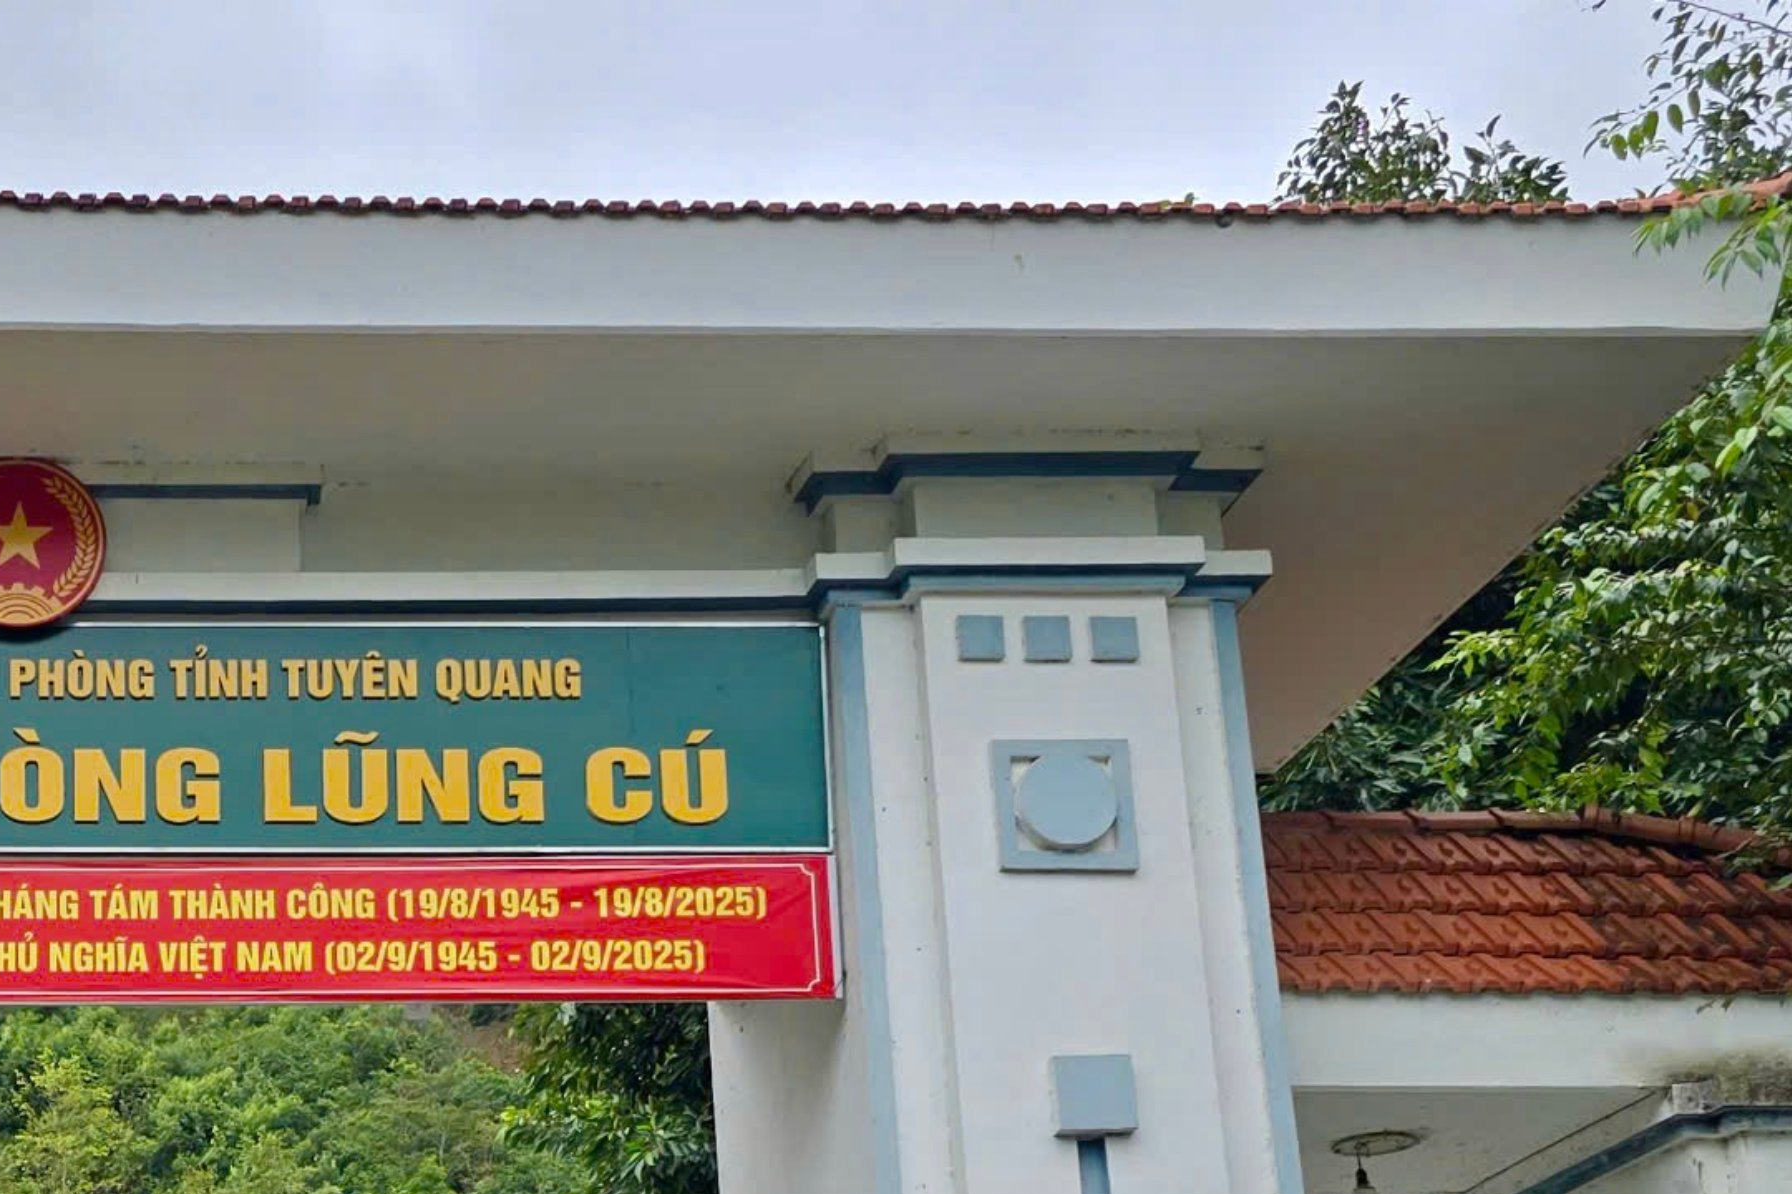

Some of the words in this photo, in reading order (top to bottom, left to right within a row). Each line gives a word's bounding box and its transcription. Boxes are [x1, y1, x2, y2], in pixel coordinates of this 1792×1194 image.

[10, 650, 154, 699] PHÒNG
[171, 645, 268, 699] TỈNH
[283, 650, 418, 700] TUYÊN
[436, 658, 582, 703] QUANG
[263, 731, 546, 824] LŨNG
[584, 728, 729, 824] CÚ
[90, 884, 159, 920] TÁM
[168, 883, 278, 920] THÀNH
[287, 883, 377, 920] CÔNG
[387, 886, 562, 920] (19/8/1945
[595, 884, 767, 918] 19/8/2025)
[47, 936, 148, 973] NGHĨA
[159, 934, 227, 978] VIỆT
[234, 941, 315, 974] NAM
[324, 940, 499, 975] (02/9/1945
[529, 938, 706, 973] 02/9/2025)
